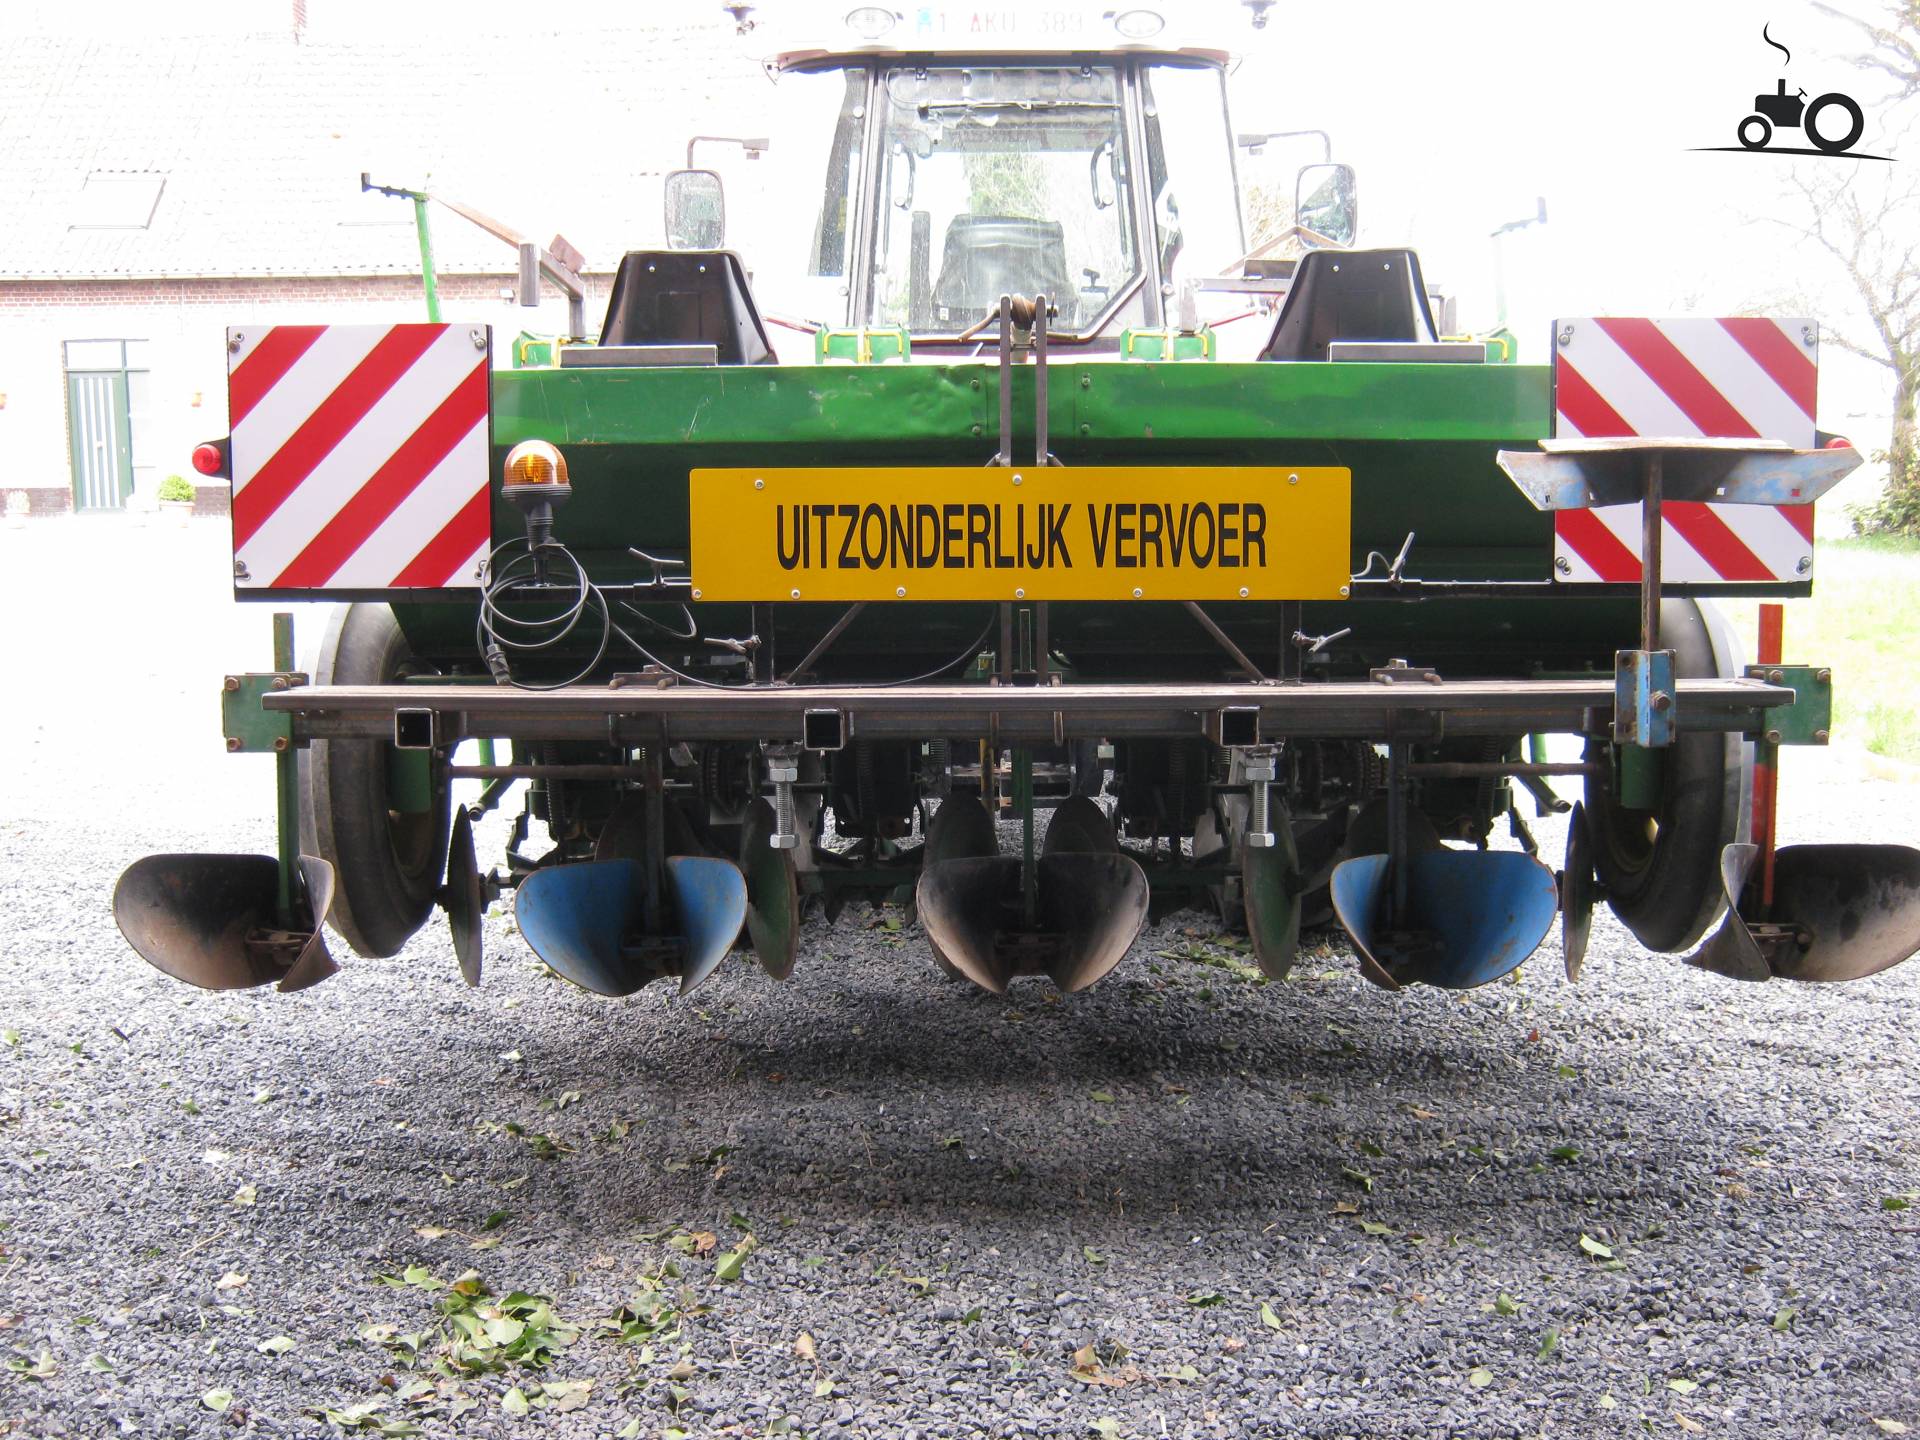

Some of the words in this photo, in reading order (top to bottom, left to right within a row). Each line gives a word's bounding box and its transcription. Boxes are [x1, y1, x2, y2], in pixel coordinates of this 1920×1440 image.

[970, 12, 1016, 33] AKU
[776, 502, 1073, 570] UITZONDERLIJK
[1087, 501, 1267, 569] VERVOER
